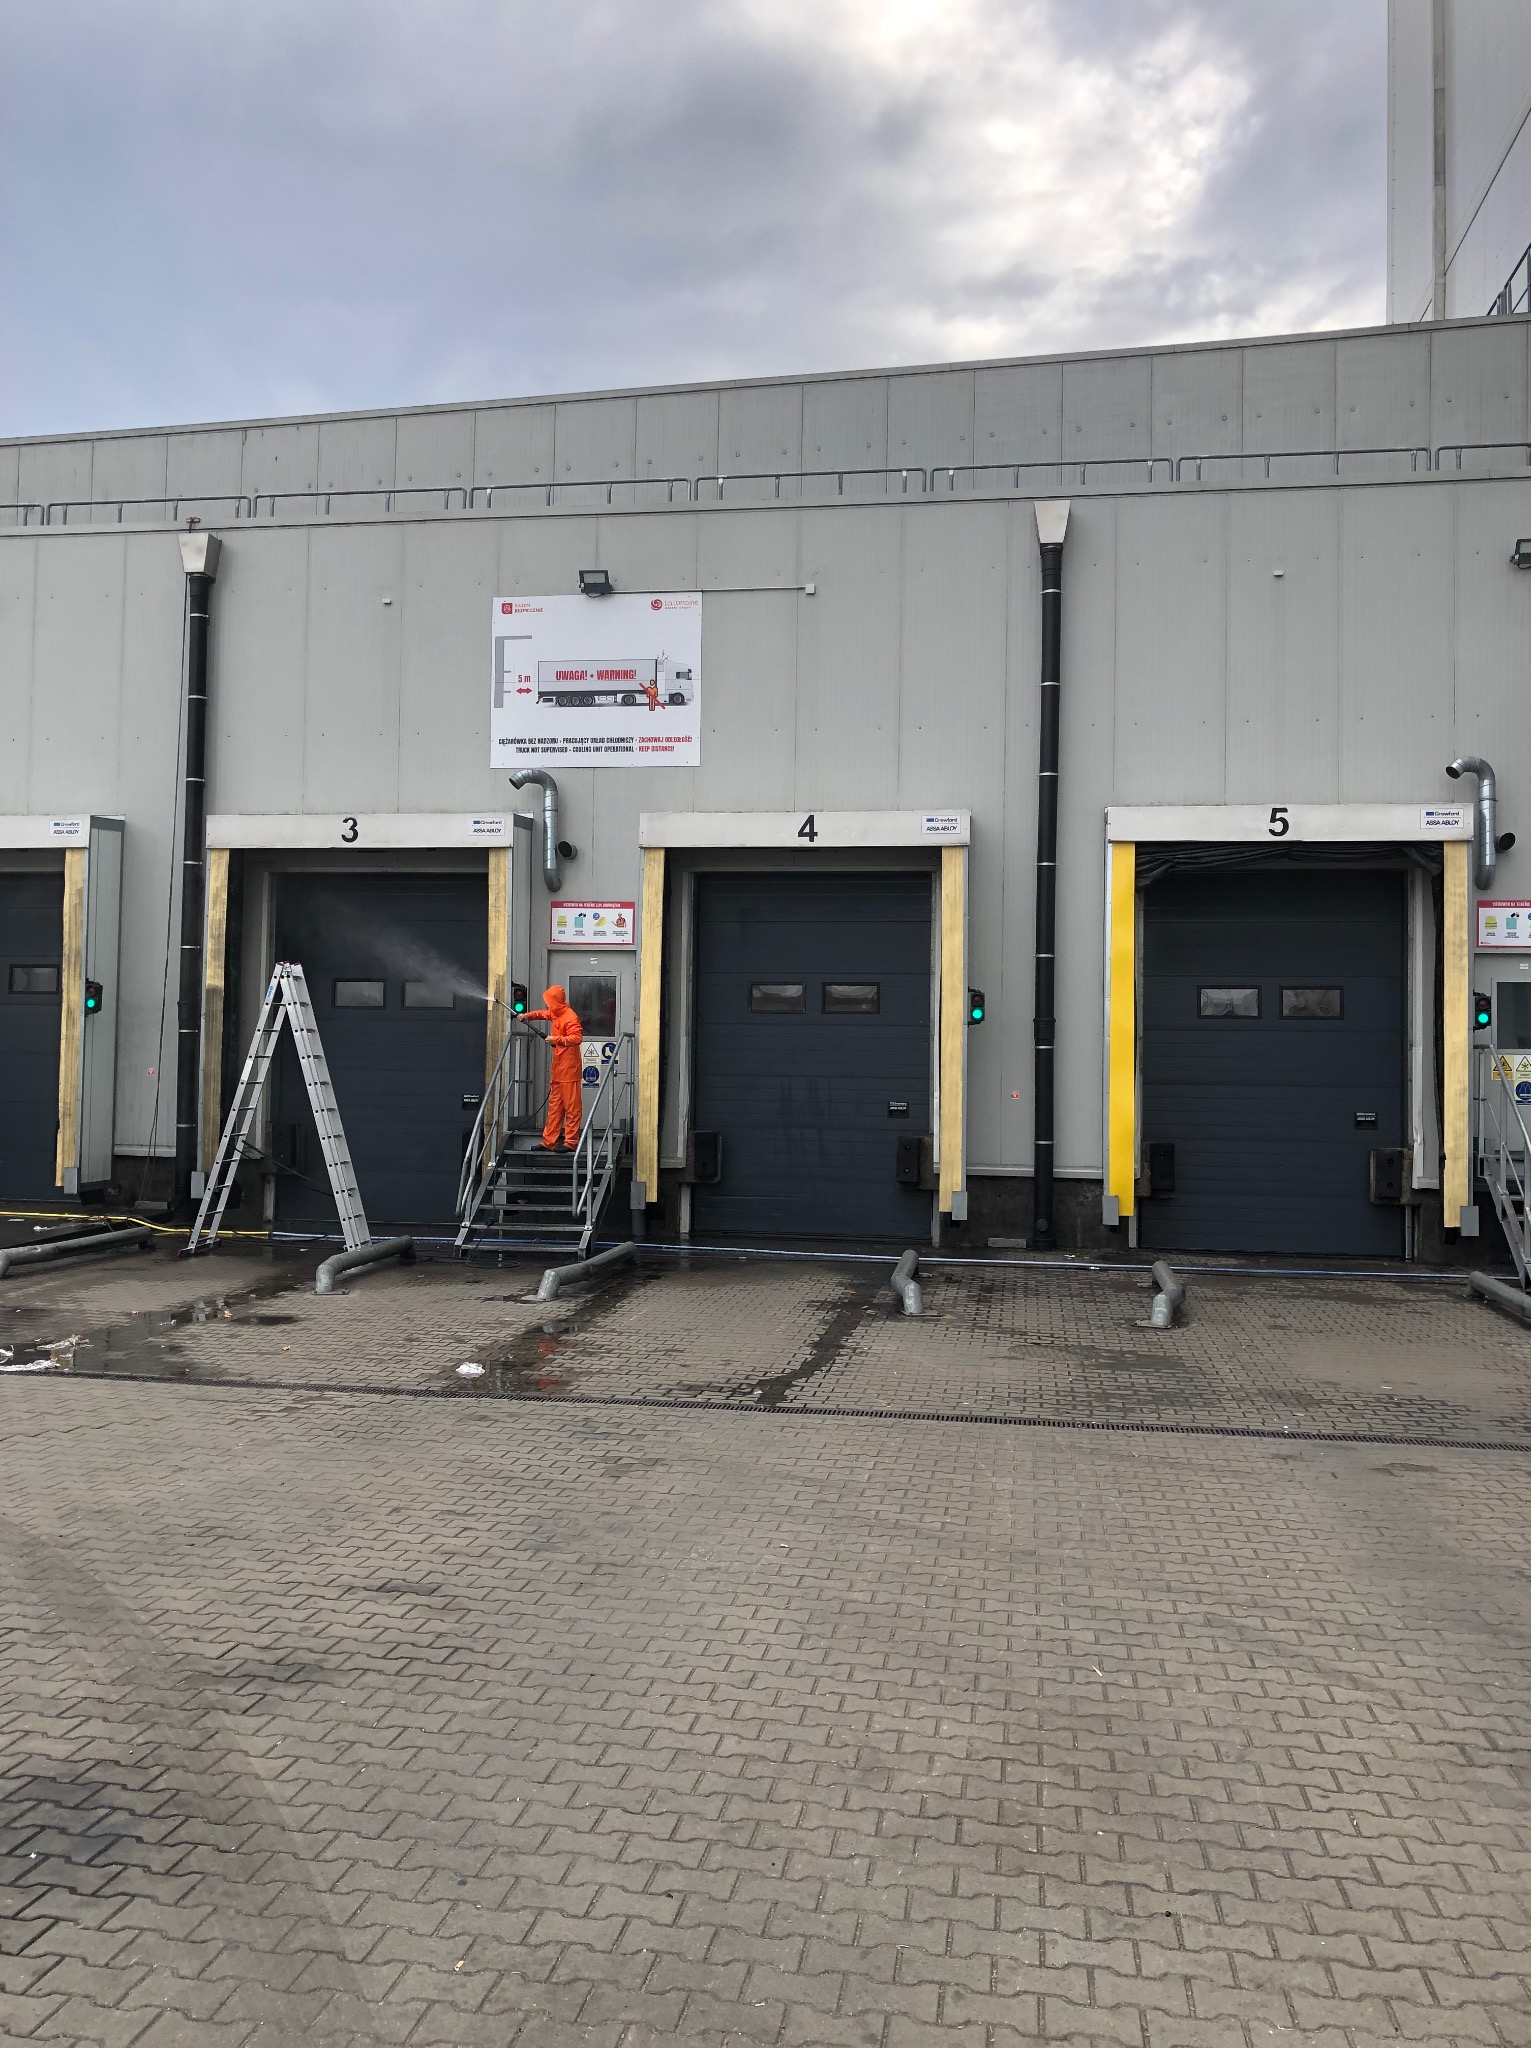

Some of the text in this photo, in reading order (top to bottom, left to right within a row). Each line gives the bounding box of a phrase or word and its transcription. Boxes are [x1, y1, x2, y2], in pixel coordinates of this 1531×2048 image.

[556, 670, 636, 680] UWAGA! WARNING!
[498, 737, 527, 746] CIĘŻARÓWKA
[341, 817, 358, 843] 3
[798, 815, 818, 842] 4
[1268, 808, 1289, 836] 5
